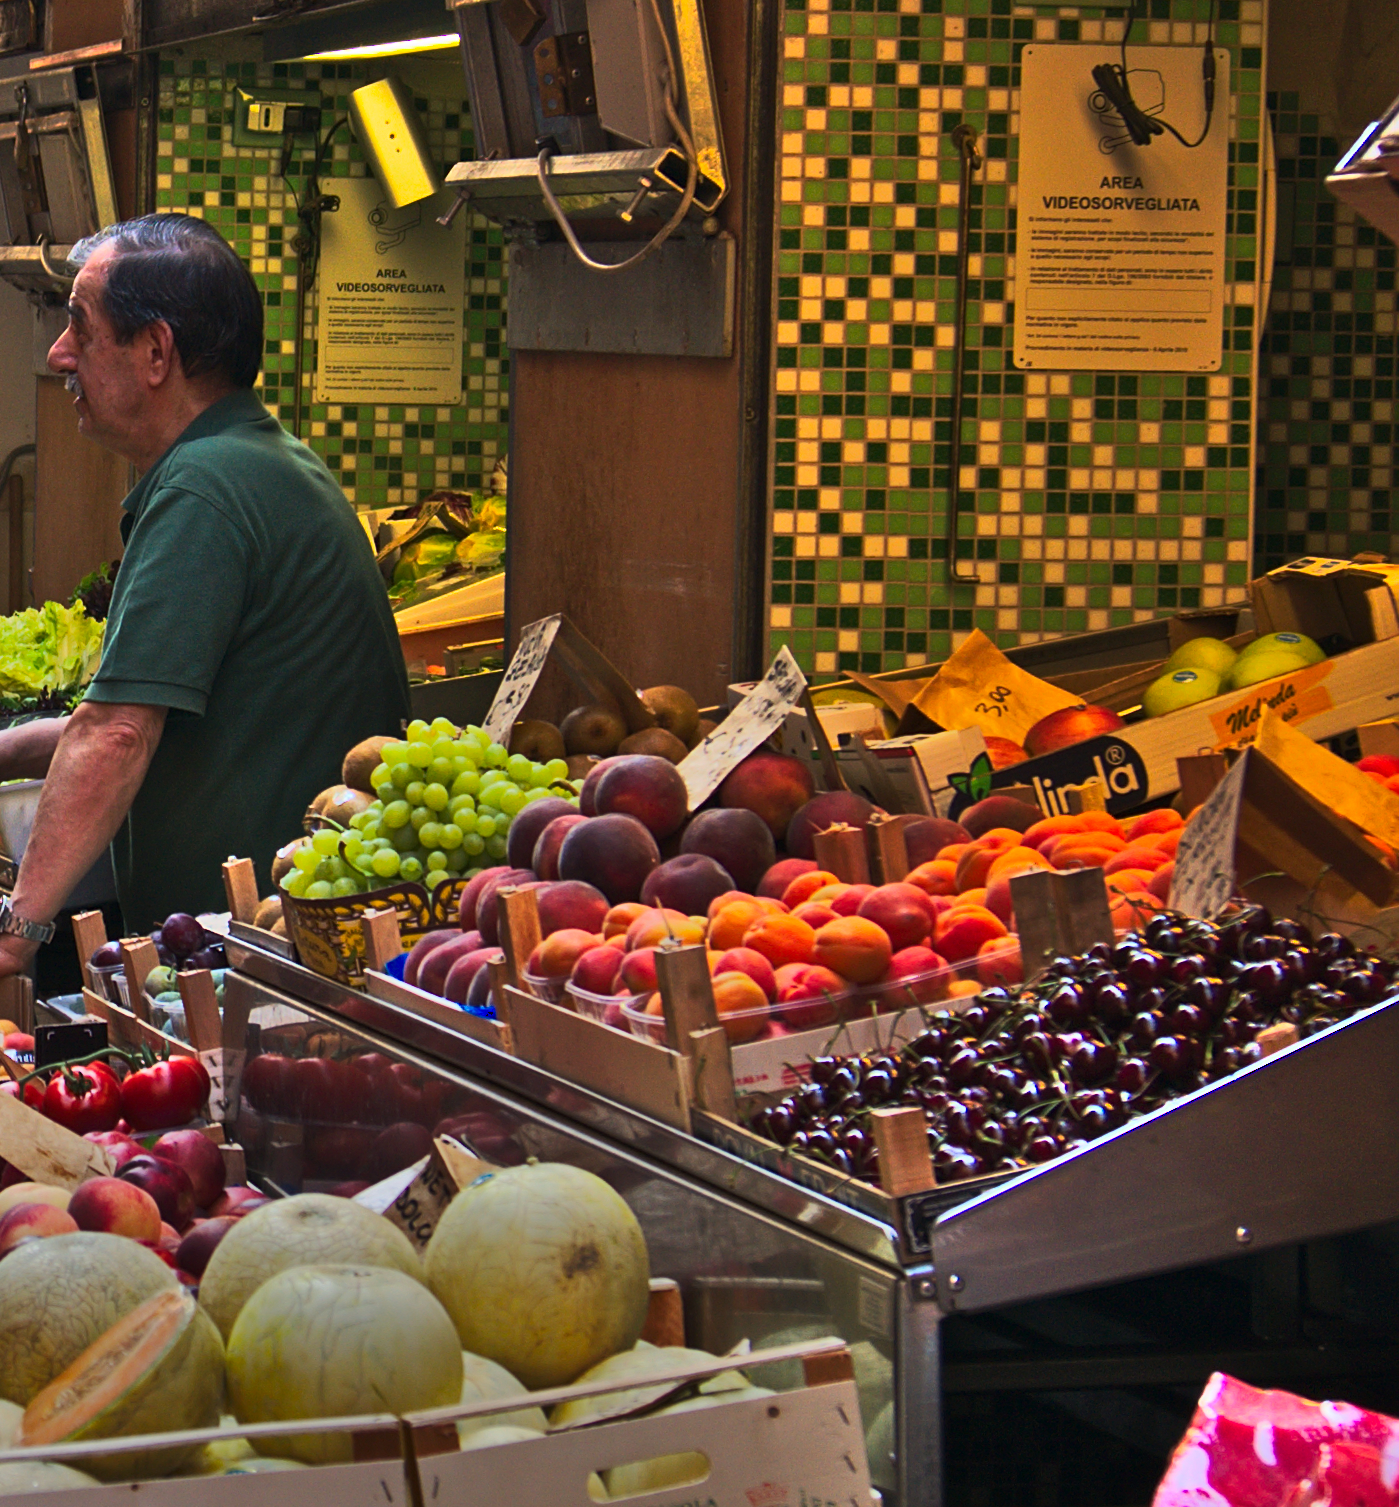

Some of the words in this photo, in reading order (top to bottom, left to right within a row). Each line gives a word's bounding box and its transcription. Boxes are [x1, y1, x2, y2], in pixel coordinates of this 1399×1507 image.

[1100, 177, 1144, 189] AREA
[1042, 196, 1200, 211] VIDEOSORVEGLIATA
[376, 269, 407, 279] AREA
[337, 283, 446, 294] VIDEOSORVEGLIATA
[975, 685, 1012, 718] 3,00
